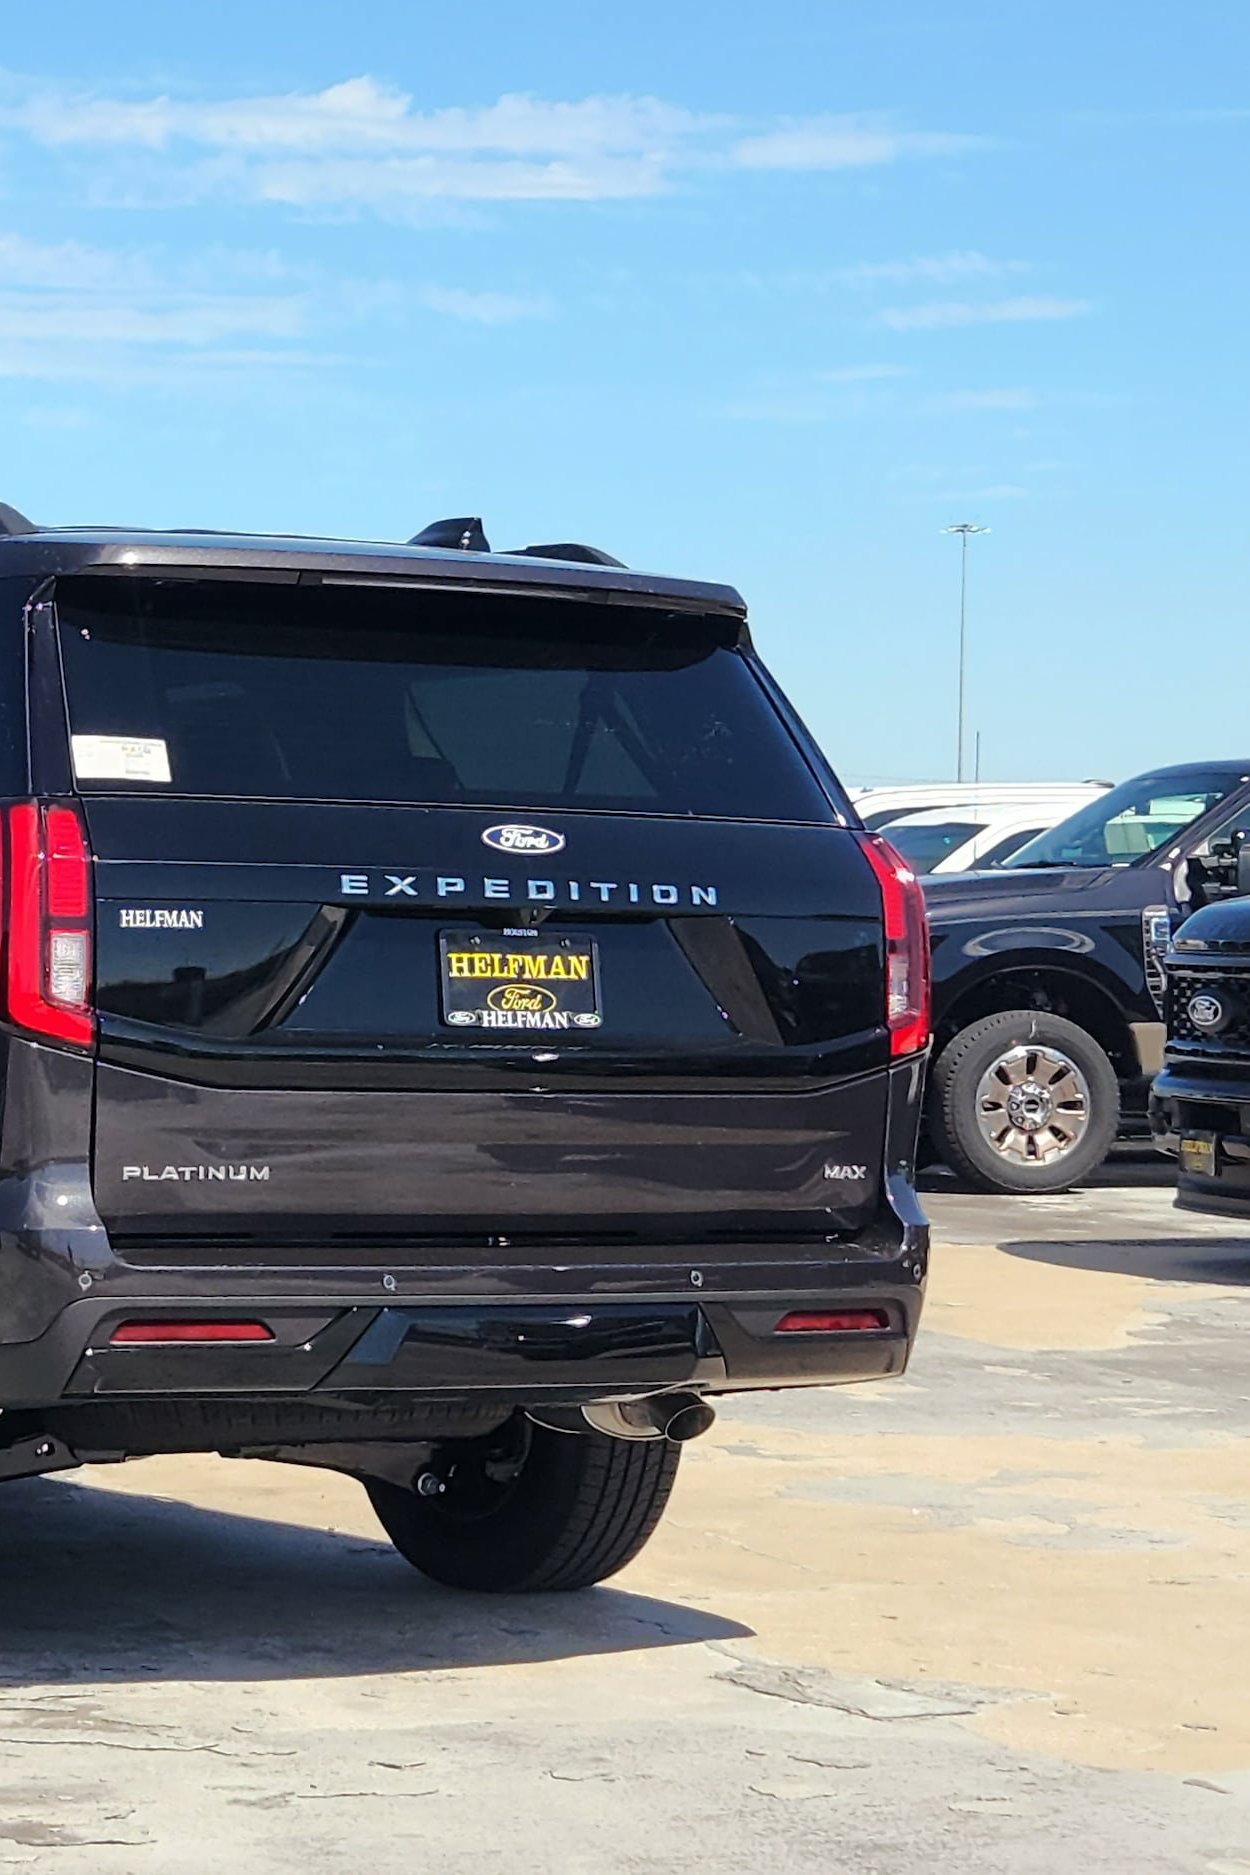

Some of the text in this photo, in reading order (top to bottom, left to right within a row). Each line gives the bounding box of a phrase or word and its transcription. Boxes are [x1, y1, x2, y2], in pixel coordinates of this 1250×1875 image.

[340, 873, 718, 906] EXPEDITION
[119, 909, 204, 929] HELFMAN
[447, 952, 591, 980] HELFMAN
[480, 1009, 571, 1029] HELFMAN
[122, 1165, 271, 1181] PLATINUM
[823, 1164, 868, 1180] MAX
